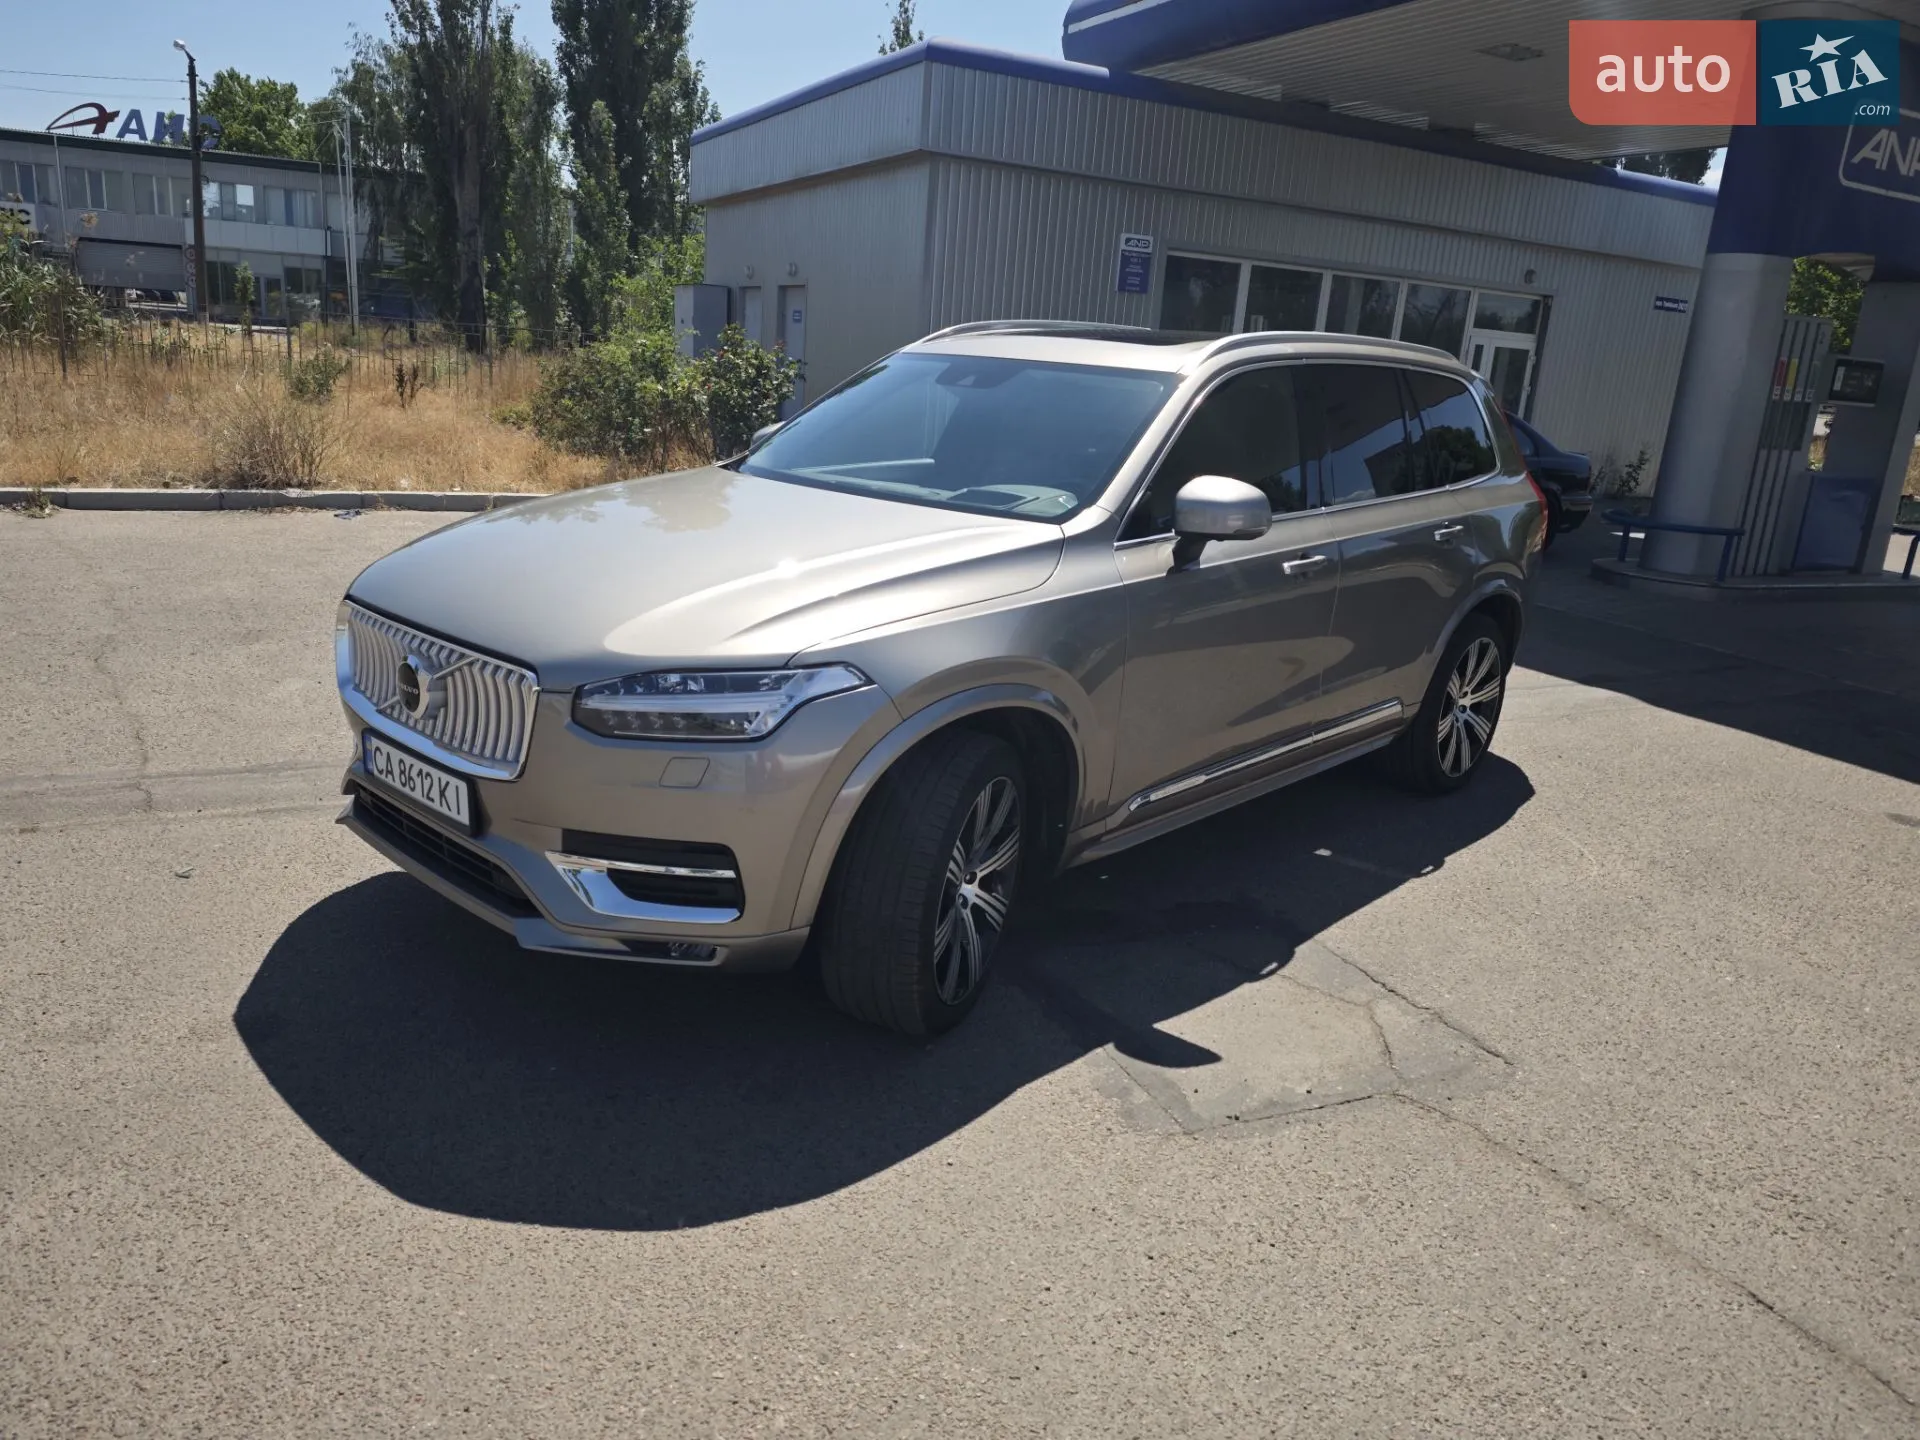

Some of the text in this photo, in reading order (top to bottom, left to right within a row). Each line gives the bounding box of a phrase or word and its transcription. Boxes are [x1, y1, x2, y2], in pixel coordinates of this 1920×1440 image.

[374, 746, 460, 816] CA 8612 KI
